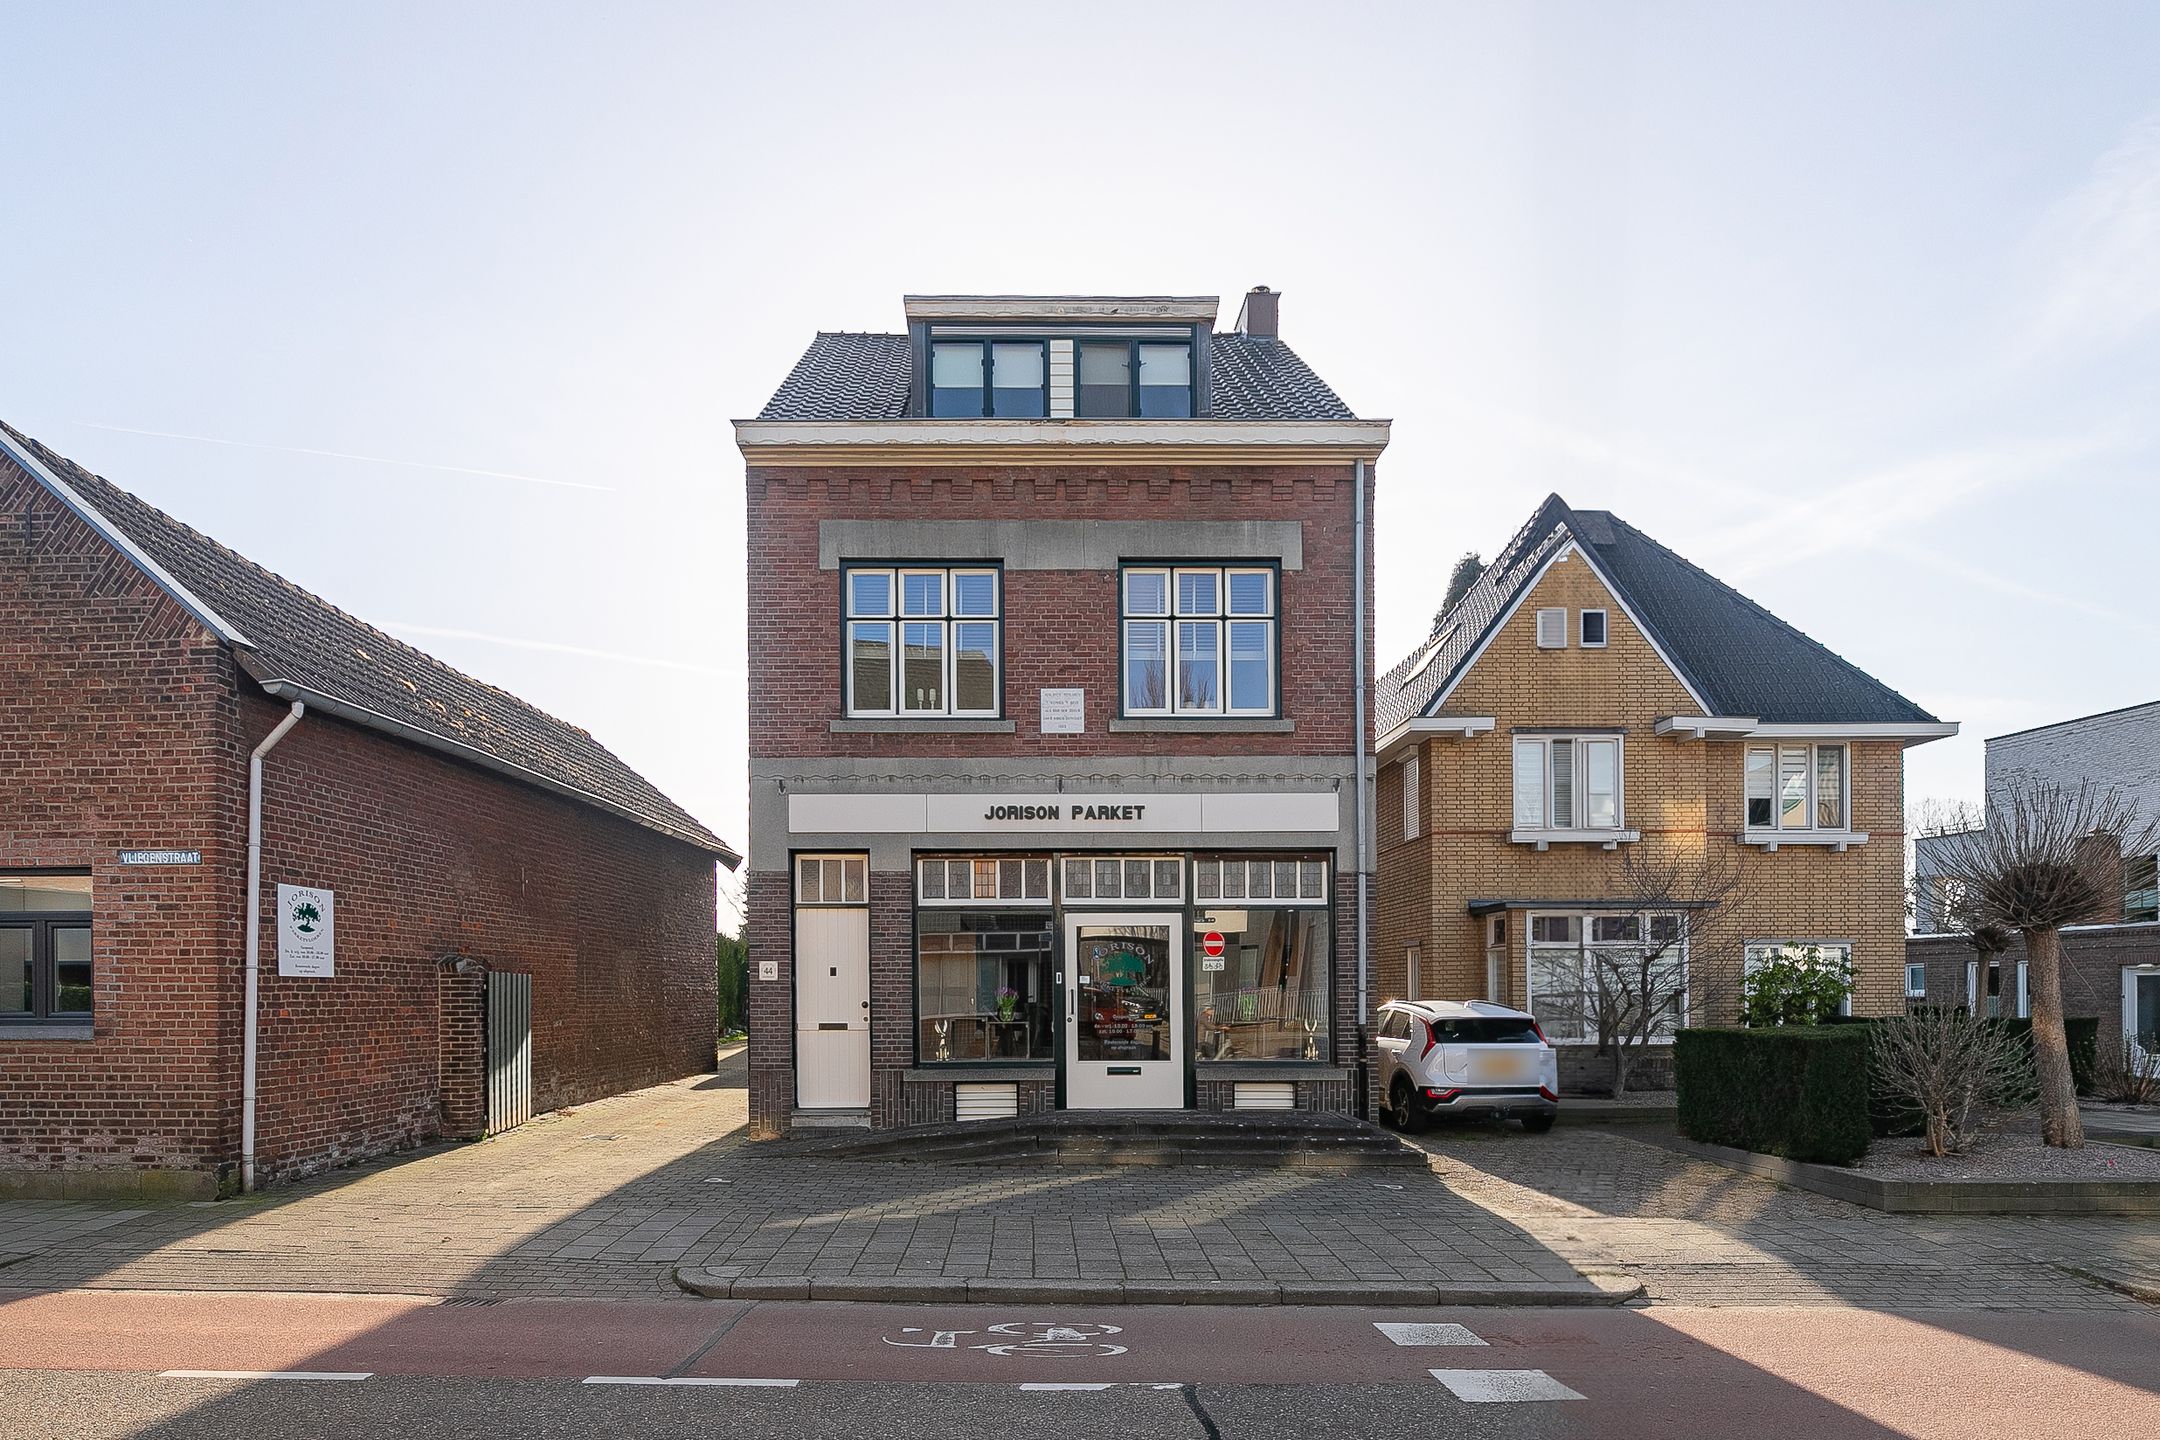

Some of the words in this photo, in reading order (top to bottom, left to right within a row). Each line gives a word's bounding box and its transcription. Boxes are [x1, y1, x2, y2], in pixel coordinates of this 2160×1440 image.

[984, 805, 1060, 820] JORISON
[1071, 805, 1146, 820] PARKET
[122, 851, 199, 863] VLIEGENSTRAAT
[287, 890, 326, 912] JORISON
[1097, 942, 1155, 964] ORISON
